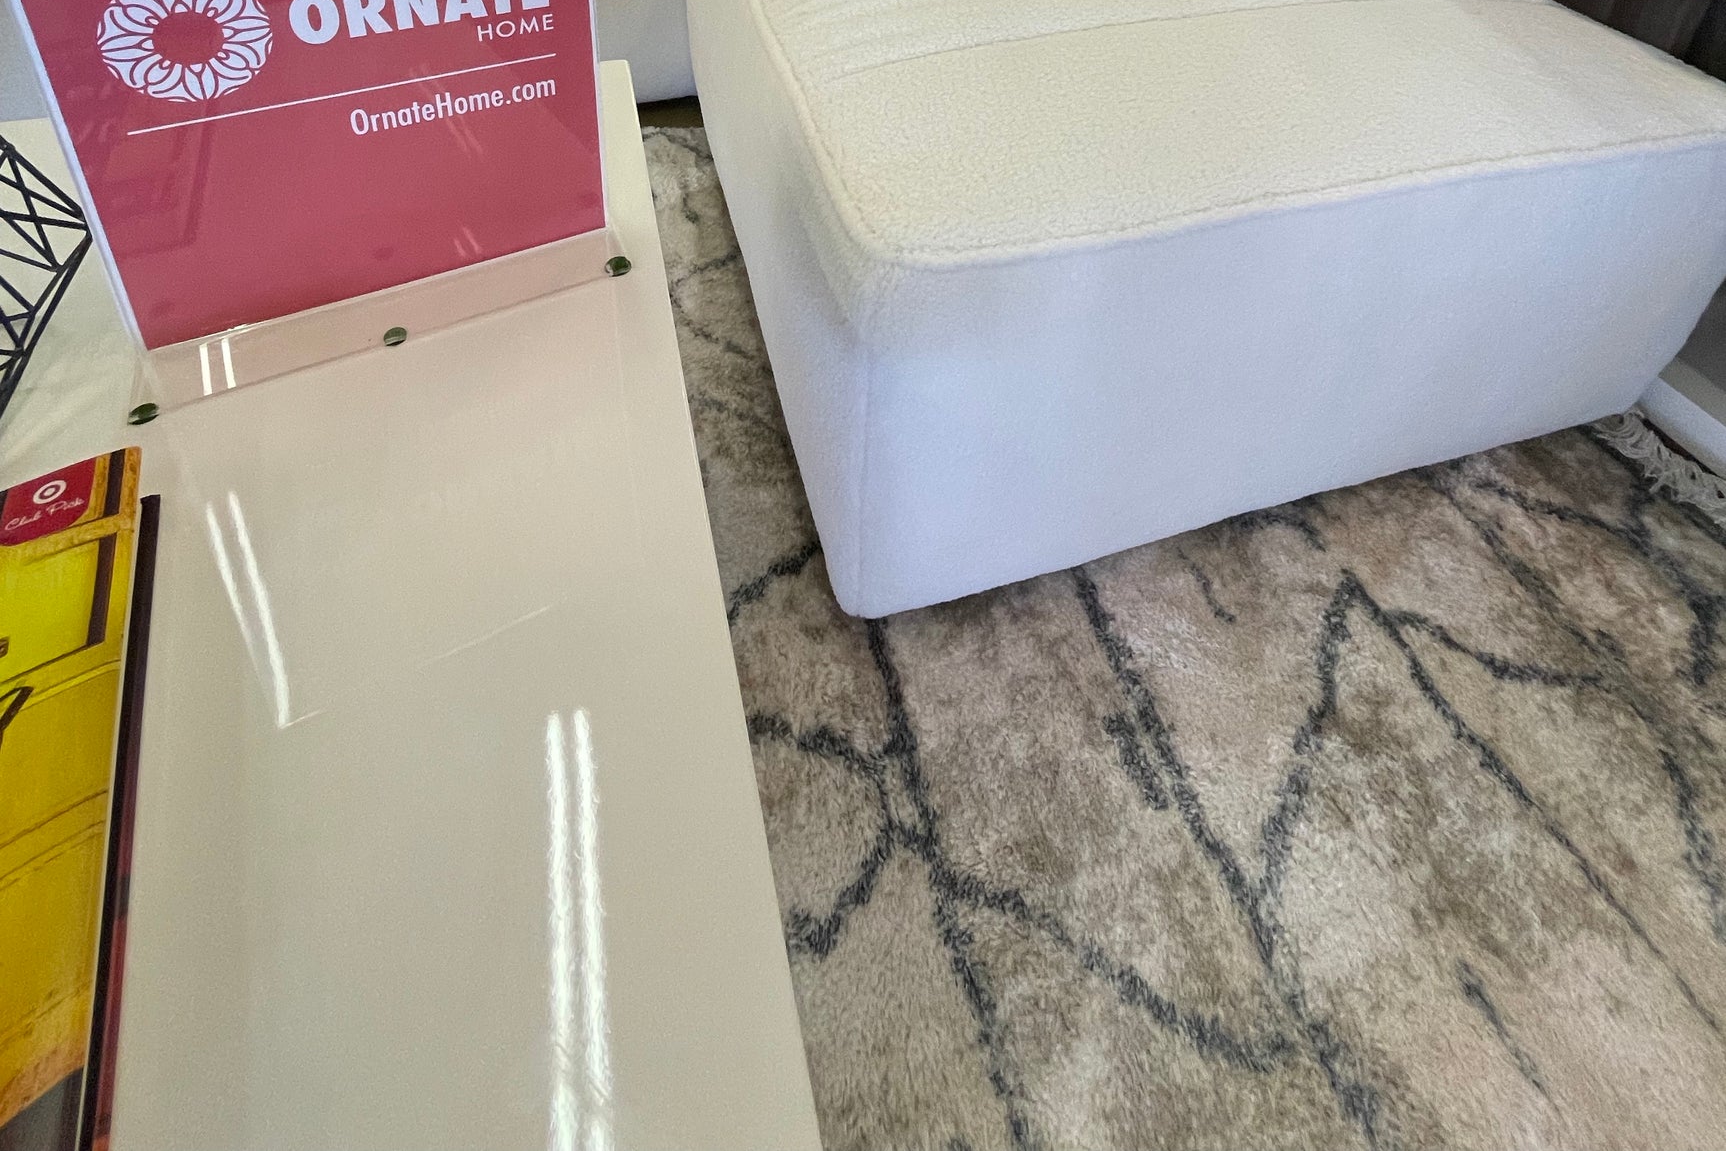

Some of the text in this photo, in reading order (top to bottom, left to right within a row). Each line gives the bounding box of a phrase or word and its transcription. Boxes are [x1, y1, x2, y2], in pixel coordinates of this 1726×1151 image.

[477, 13, 554, 42] HOME
[350, 78, 556, 135] OrnateHome.com
[5, 497, 85, 531] Club Pick
